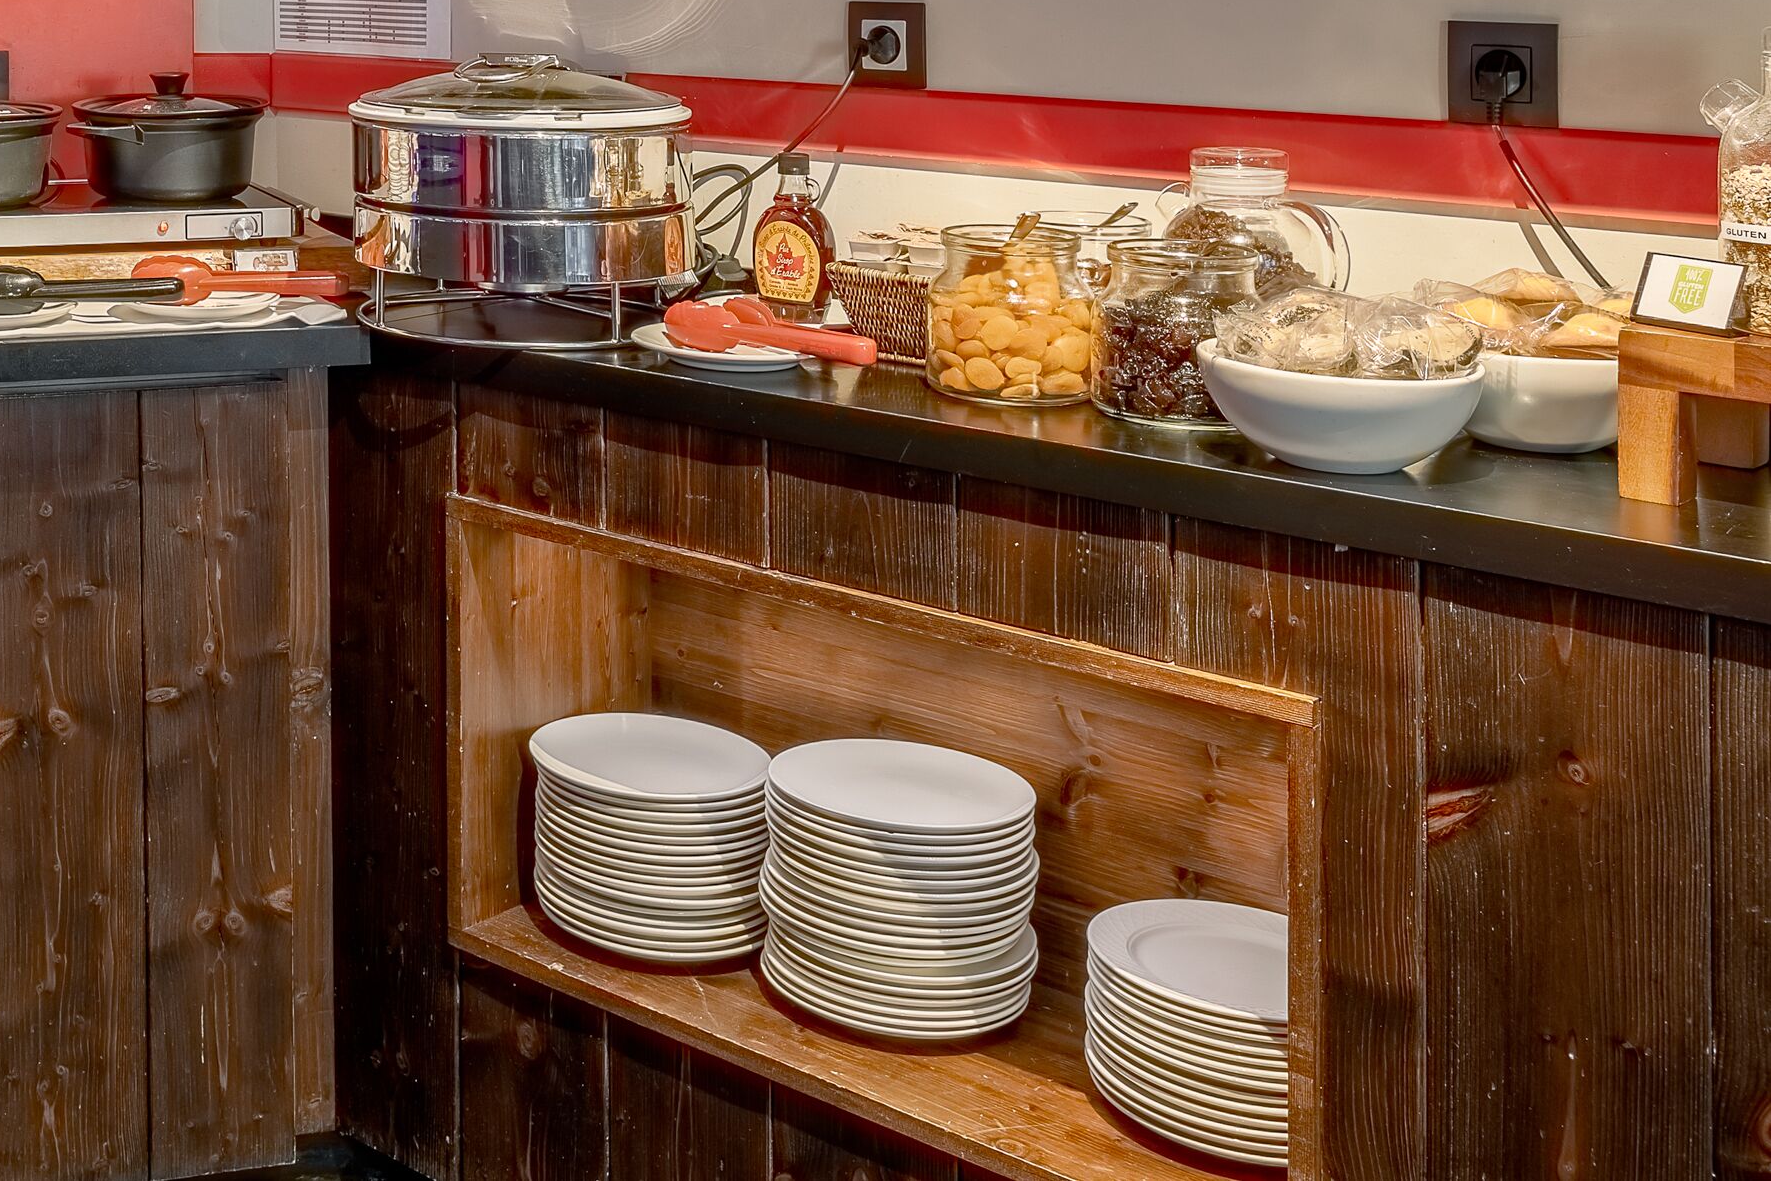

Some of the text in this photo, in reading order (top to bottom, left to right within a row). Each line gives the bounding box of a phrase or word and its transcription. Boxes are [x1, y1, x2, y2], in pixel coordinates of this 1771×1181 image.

[1725, 227, 1767, 239] GLUTEN
[779, 242, 790, 253] Pur
[776, 253, 794, 266] Sirop
[1684, 267, 1704, 282] 100%
[1673, 288, 1703, 307] FREE
